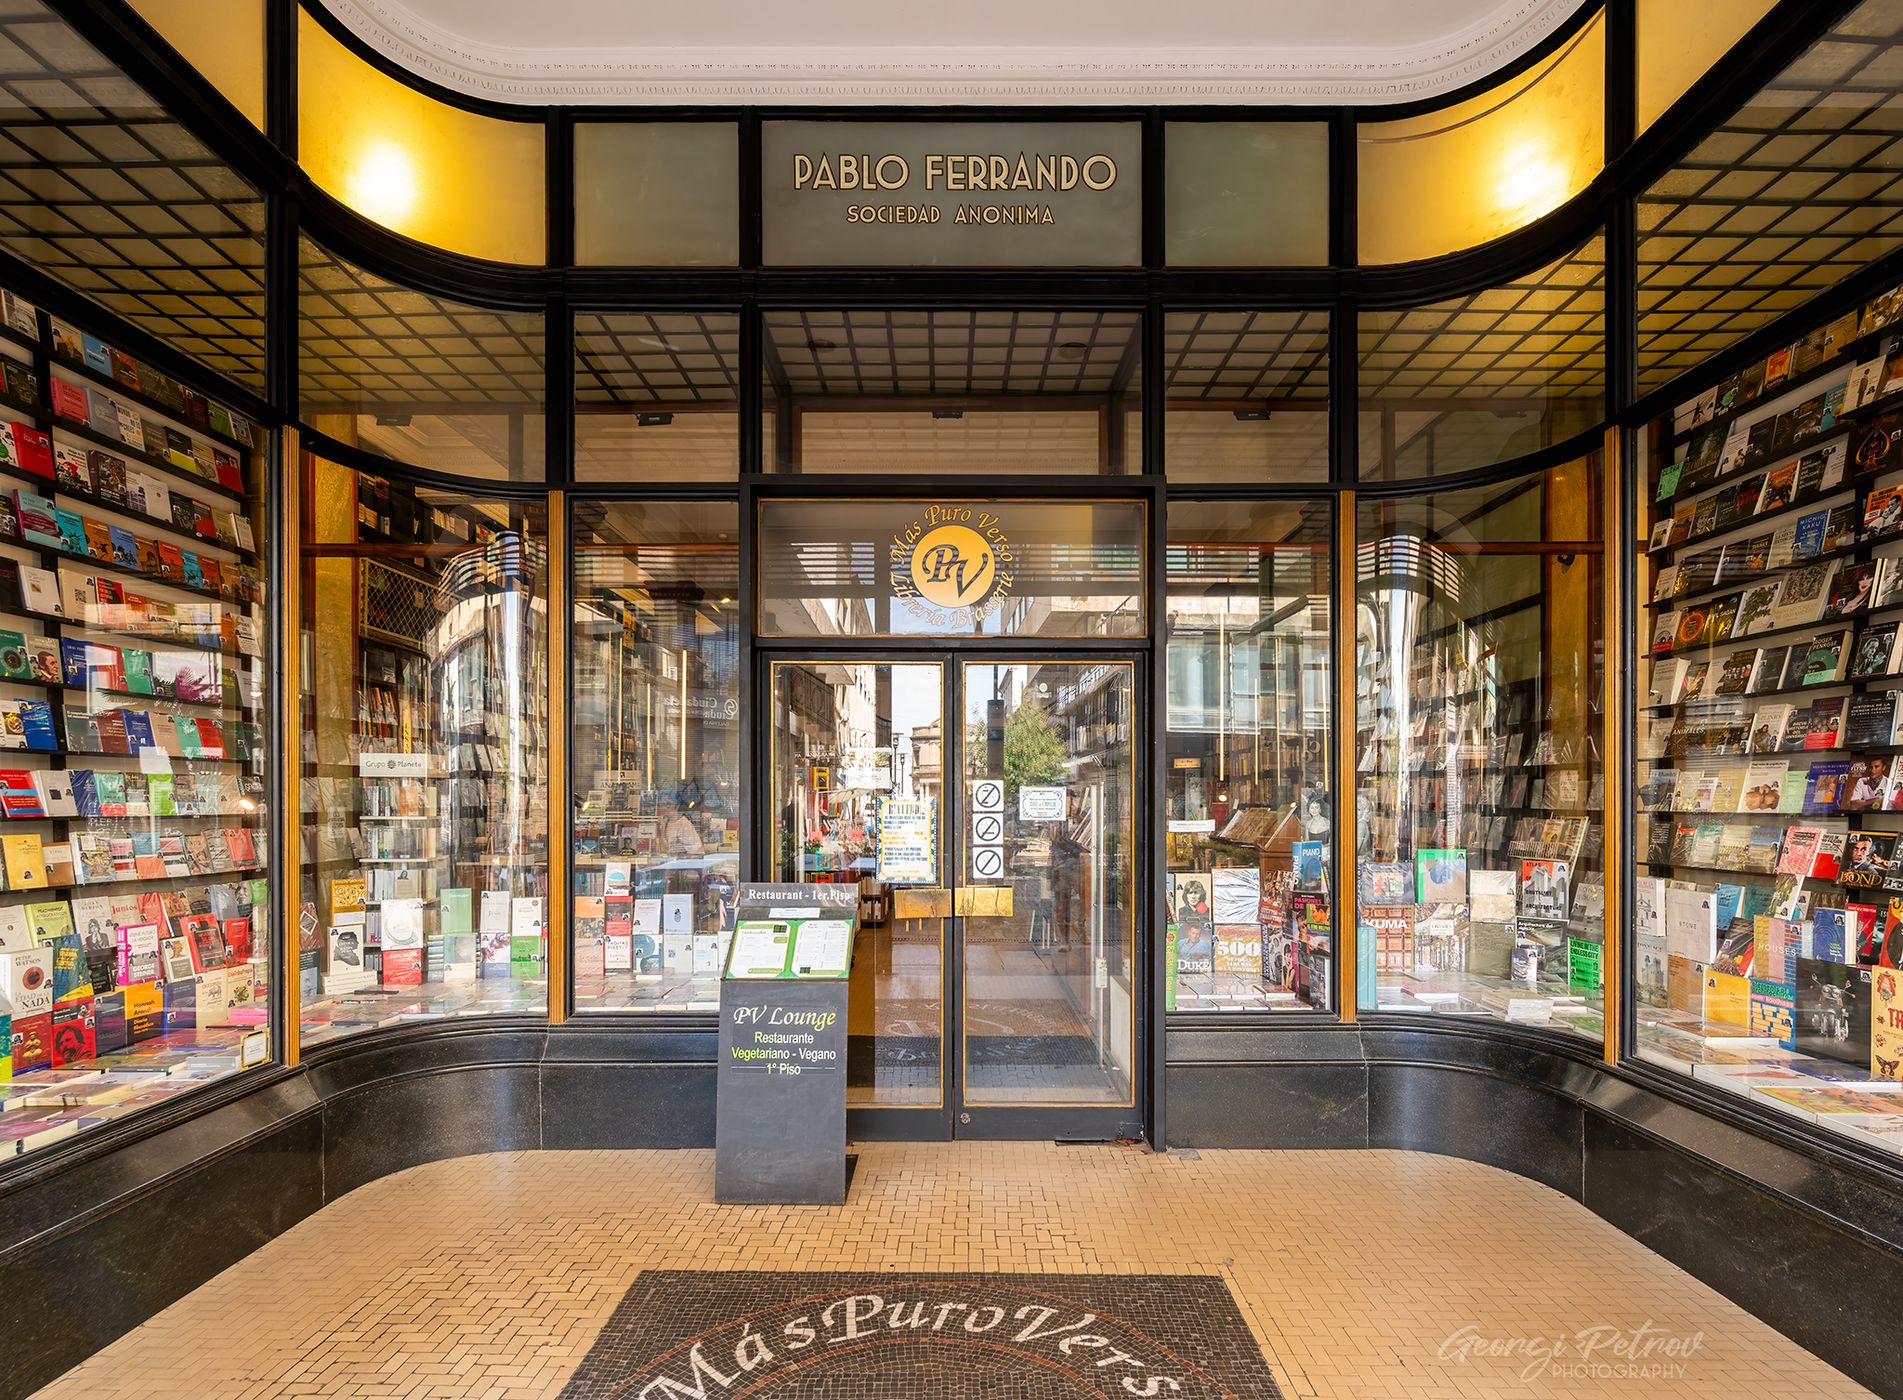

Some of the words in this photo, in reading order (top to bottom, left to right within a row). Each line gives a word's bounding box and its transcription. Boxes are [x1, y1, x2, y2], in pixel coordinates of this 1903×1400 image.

[793, 152, 910, 191] PABLO
[925, 151, 1118, 191] FERRANDO
[846, 204, 940, 225] SOCIEDAD
[954, 204, 1055, 225] ANONIMA
[890, 521, 922, 565] Más
[924, 504, 972, 526] Puro
[979, 512, 1013, 562] Verso
[365, 760, 385, 769] Grupo
[397, 760, 421, 768] Planeta
[1302, 848, 1320, 857] PIANO
[1840, 871, 1882, 886] BOND
[749, 889, 803, 900] Restaurant
[1218, 942, 1260, 956] 500
[1758, 943, 1796, 957] HOUSES
[1177, 960, 1211, 970] DUKE
[22, 997, 50, 1009] NADA
[733, 1005, 767, 1025] PV
[769, 1007, 836, 1031] Lounge
[754, 1032, 814, 1044] Restaurante
[731, 1047, 790, 1062] Vegetariano
[799, 1048, 836, 1062] Vegano
[779, 1063, 801, 1075] Piso
[822, 1294, 1003, 1349] Puro
